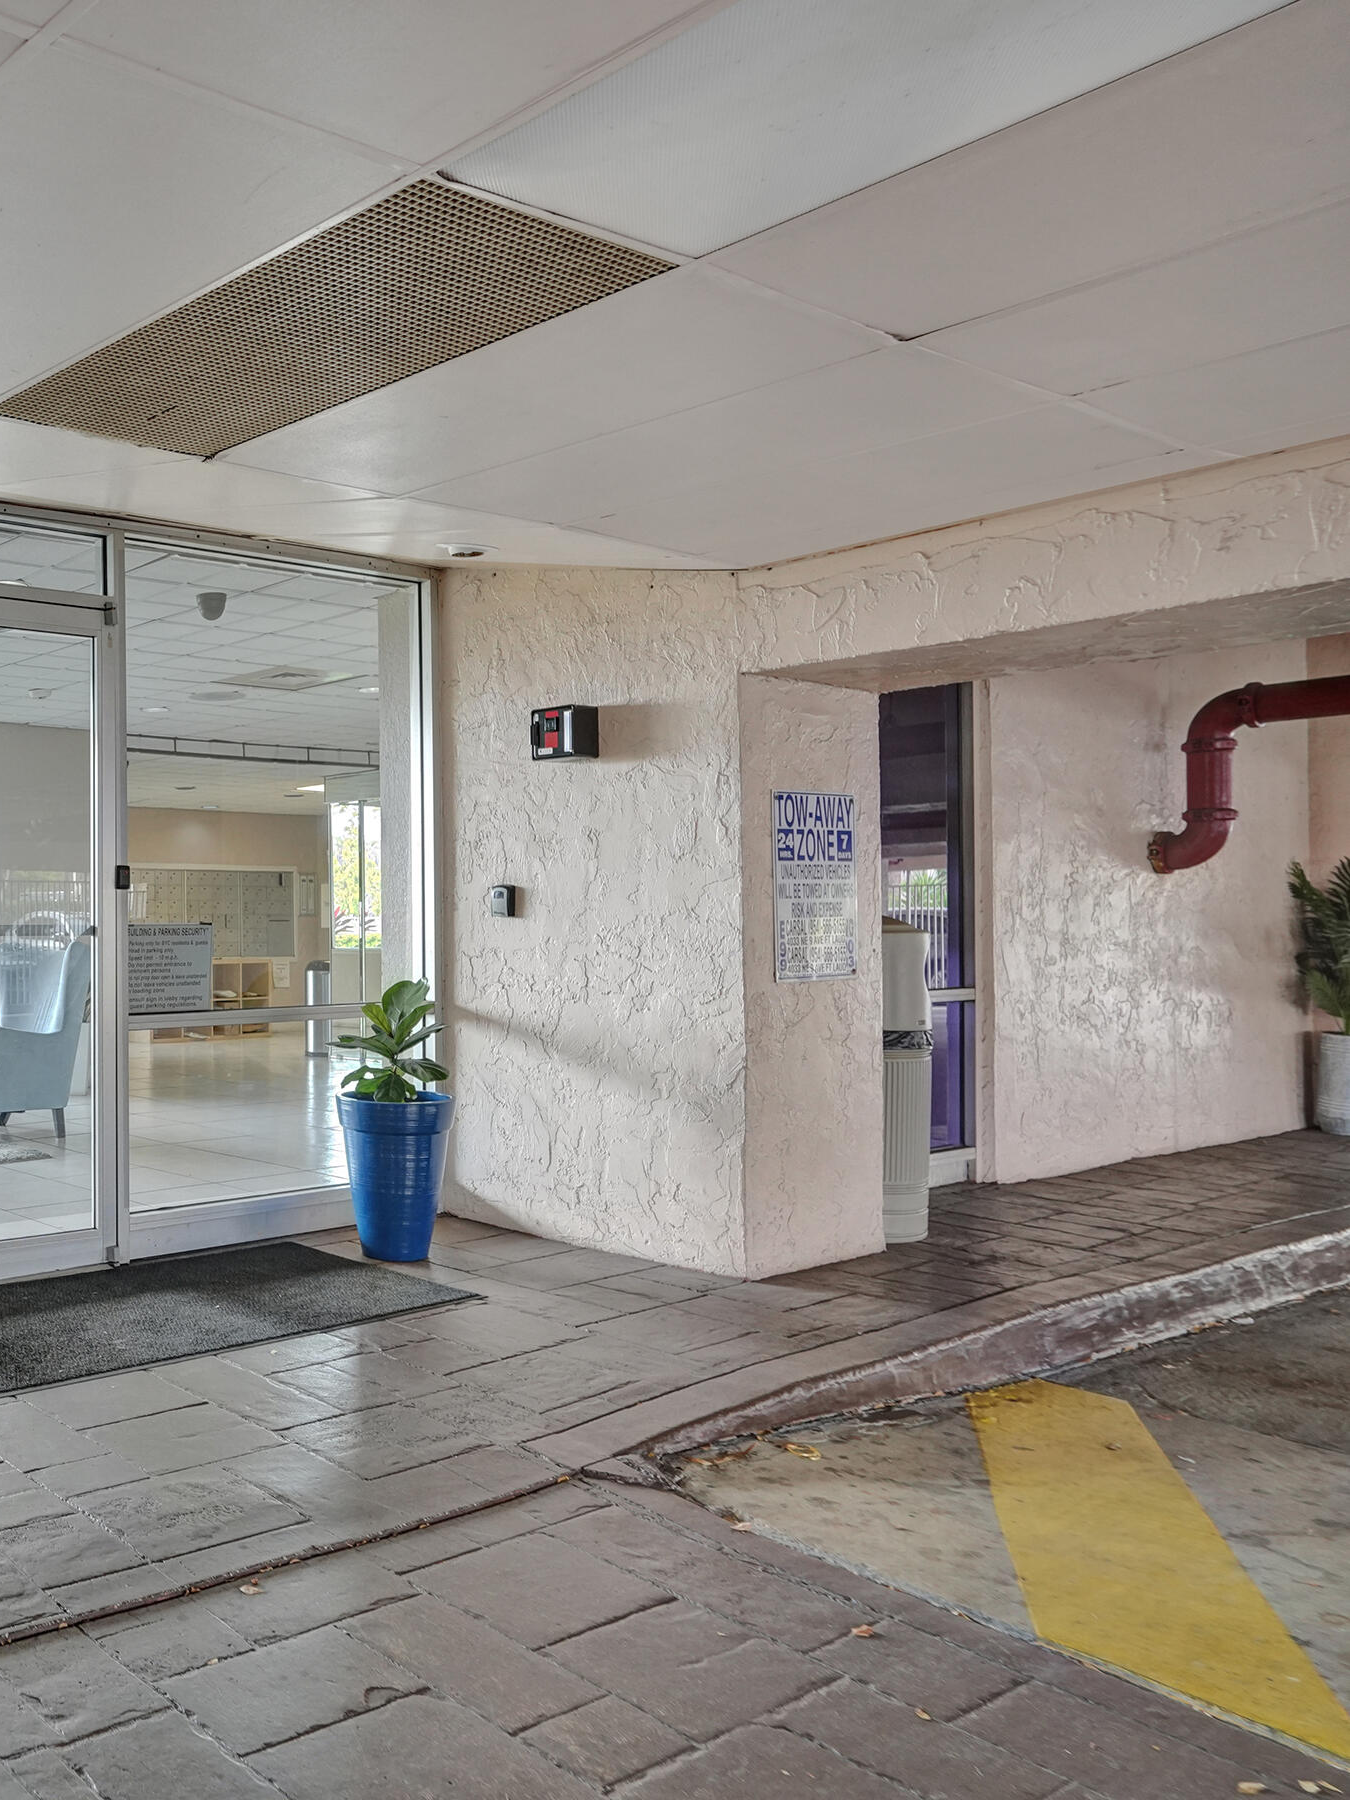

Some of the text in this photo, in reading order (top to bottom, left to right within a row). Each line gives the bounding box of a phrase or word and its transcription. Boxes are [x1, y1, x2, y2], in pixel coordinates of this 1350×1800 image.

[776, 794, 854, 829] TOW-AWAY
[778, 833, 794, 849] 24
[797, 829, 836, 862] ZONE
[841, 834, 849, 850] 7
[781, 864, 851, 880] UNAUTHORIZED VEHICLES
[778, 883, 854, 899] WILL BE TOWED AT OWNERS
[792, 902, 843, 918] RISK AND EXPENSE
[158, 927, 180, 936] PARKING
[801, 936, 809, 946] NE
[814, 935, 824, 944] AVE
[825, 935, 832, 944] FT
